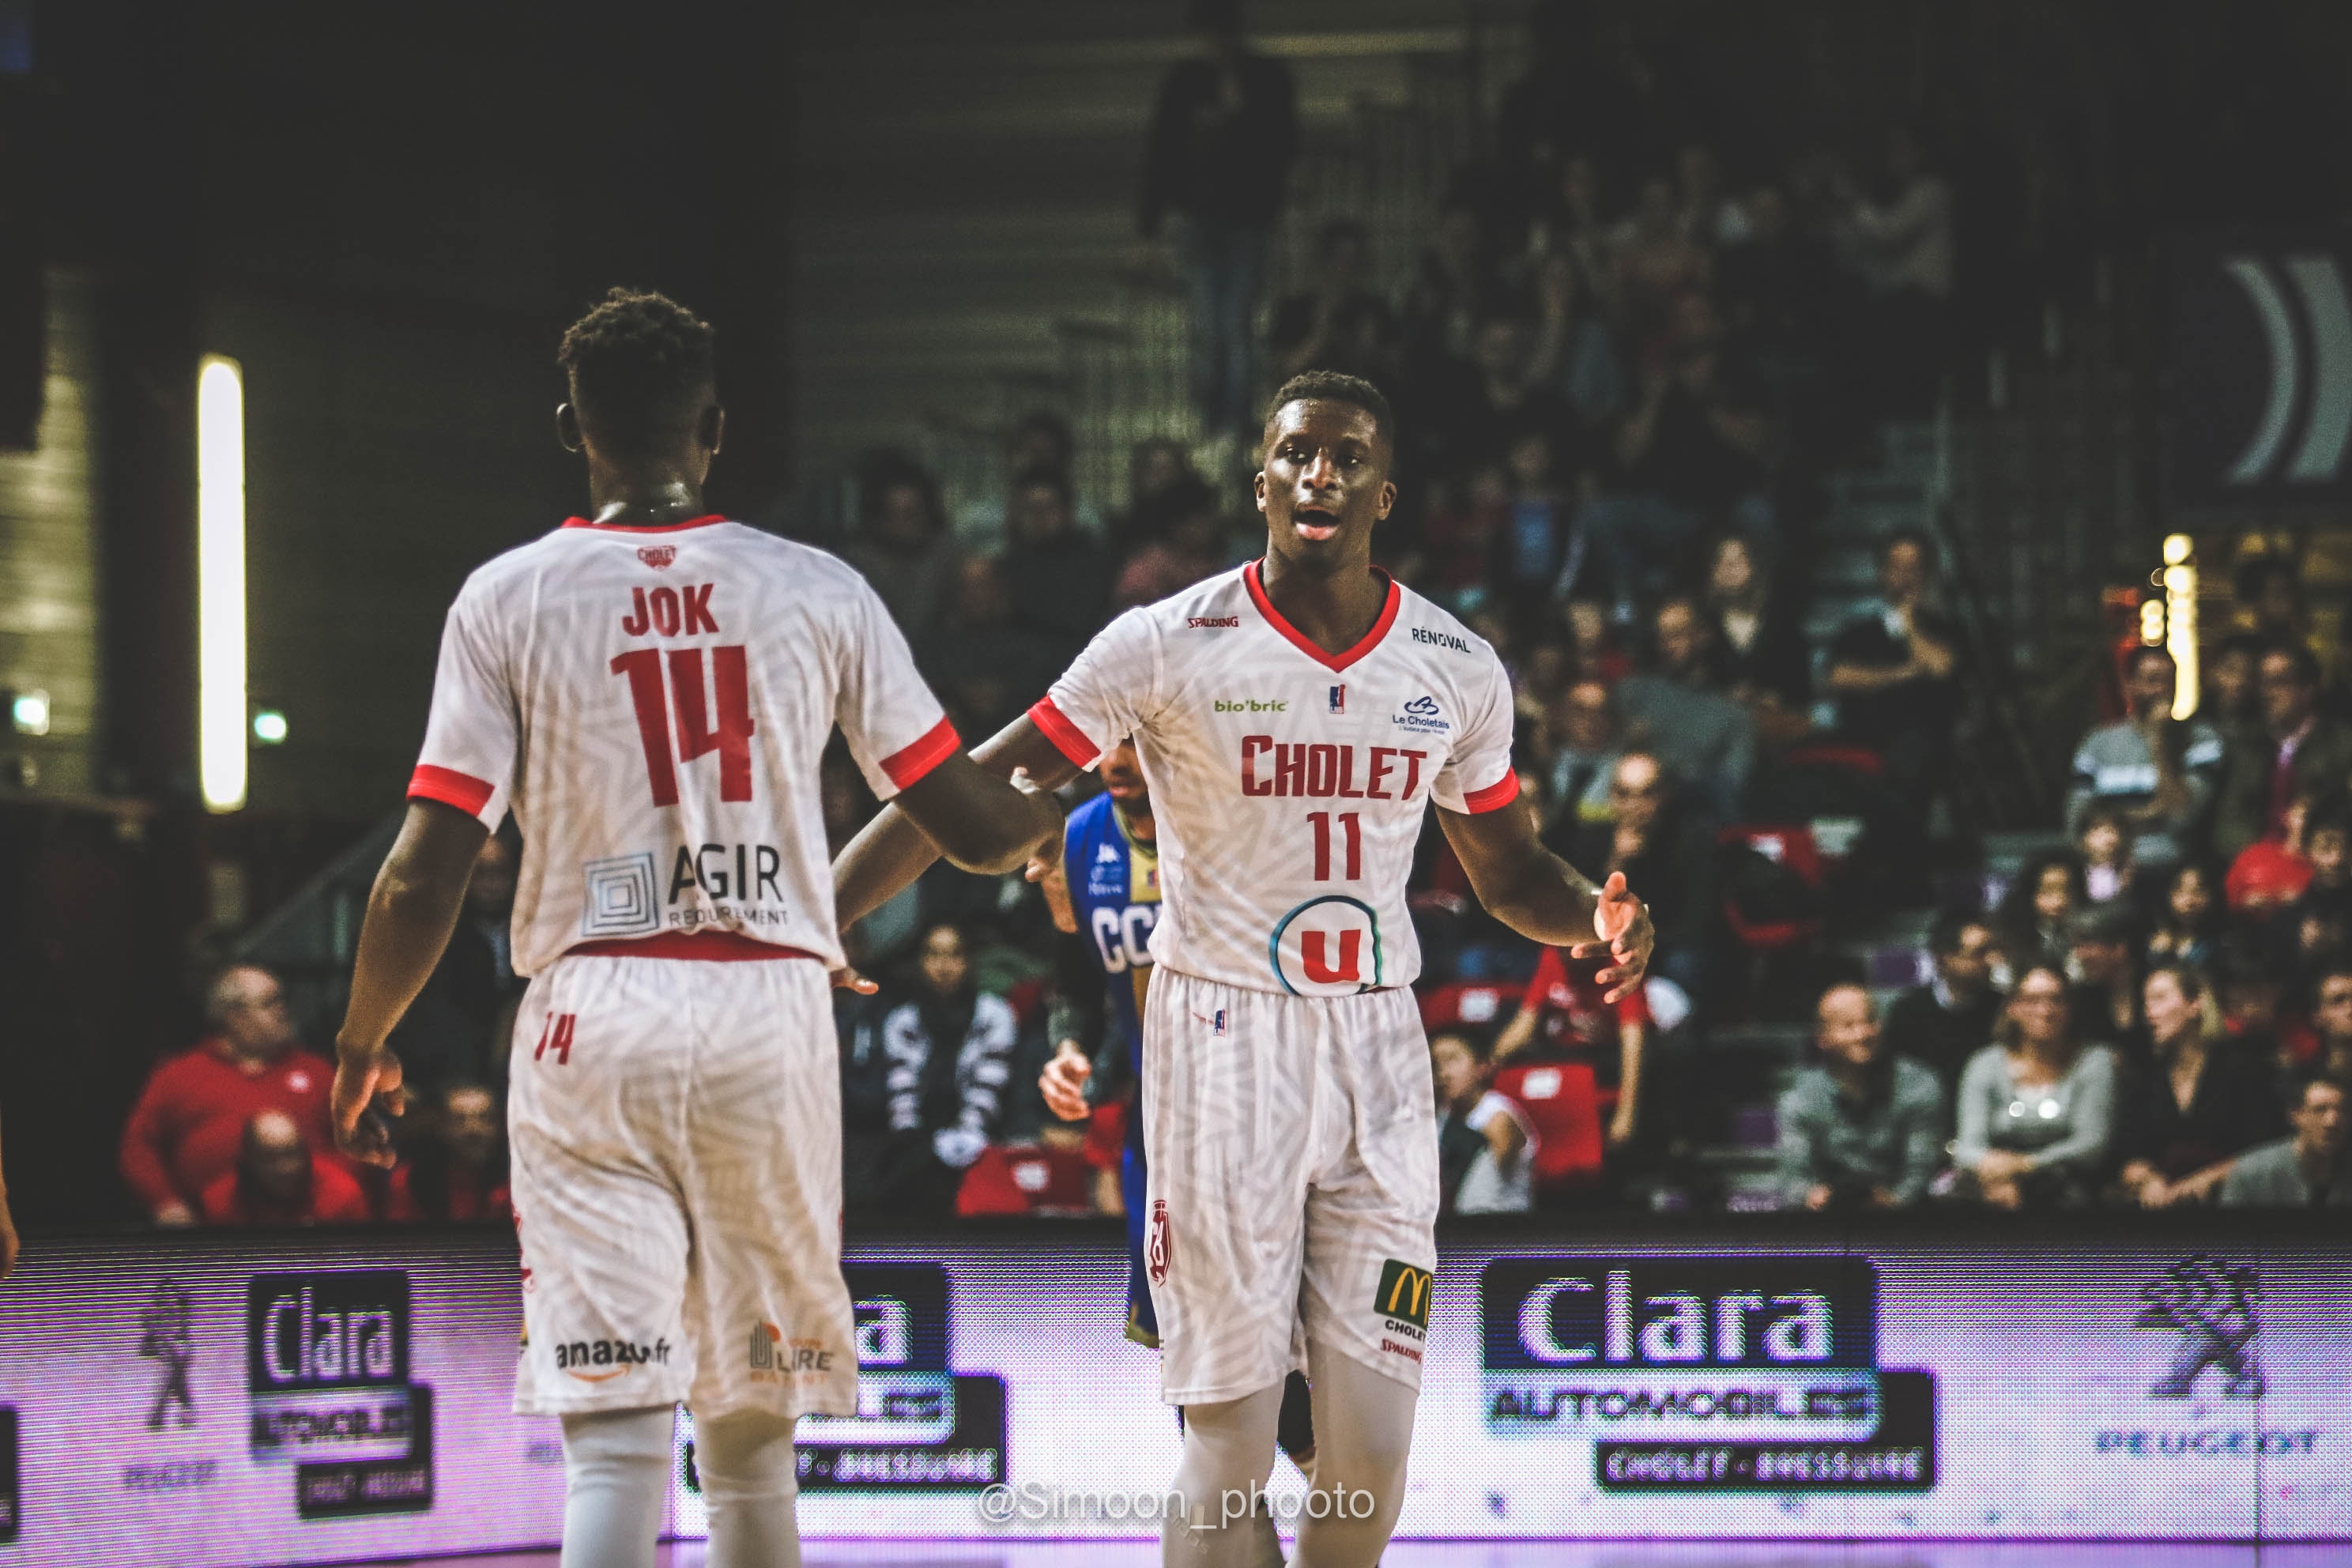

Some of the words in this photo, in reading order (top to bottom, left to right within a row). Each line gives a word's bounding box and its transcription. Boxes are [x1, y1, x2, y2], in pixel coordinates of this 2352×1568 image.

[622, 583, 719, 637] JOK
[1188, 616, 1239, 628] SPALDING
[610, 645, 754, 808] 14
[1214, 699, 1286, 712] bio'bric
[1392, 714, 1405, 724] Le
[1408, 715, 1450, 729] Choletais
[1242, 735, 1427, 801] CHOLET
[669, 843, 783, 904] AGIR
[1306, 812, 1361, 880] 11
[1092, 904, 1163, 974] CC
[534, 1012, 575, 1065] 14
[262, 1287, 394, 1381] Clara
[1518, 1269, 1834, 1363] Clara
[1493, 1389, 1874, 1421] AUTOMOBILES
[2094, 1431, 2316, 1454] PEUGEOT
